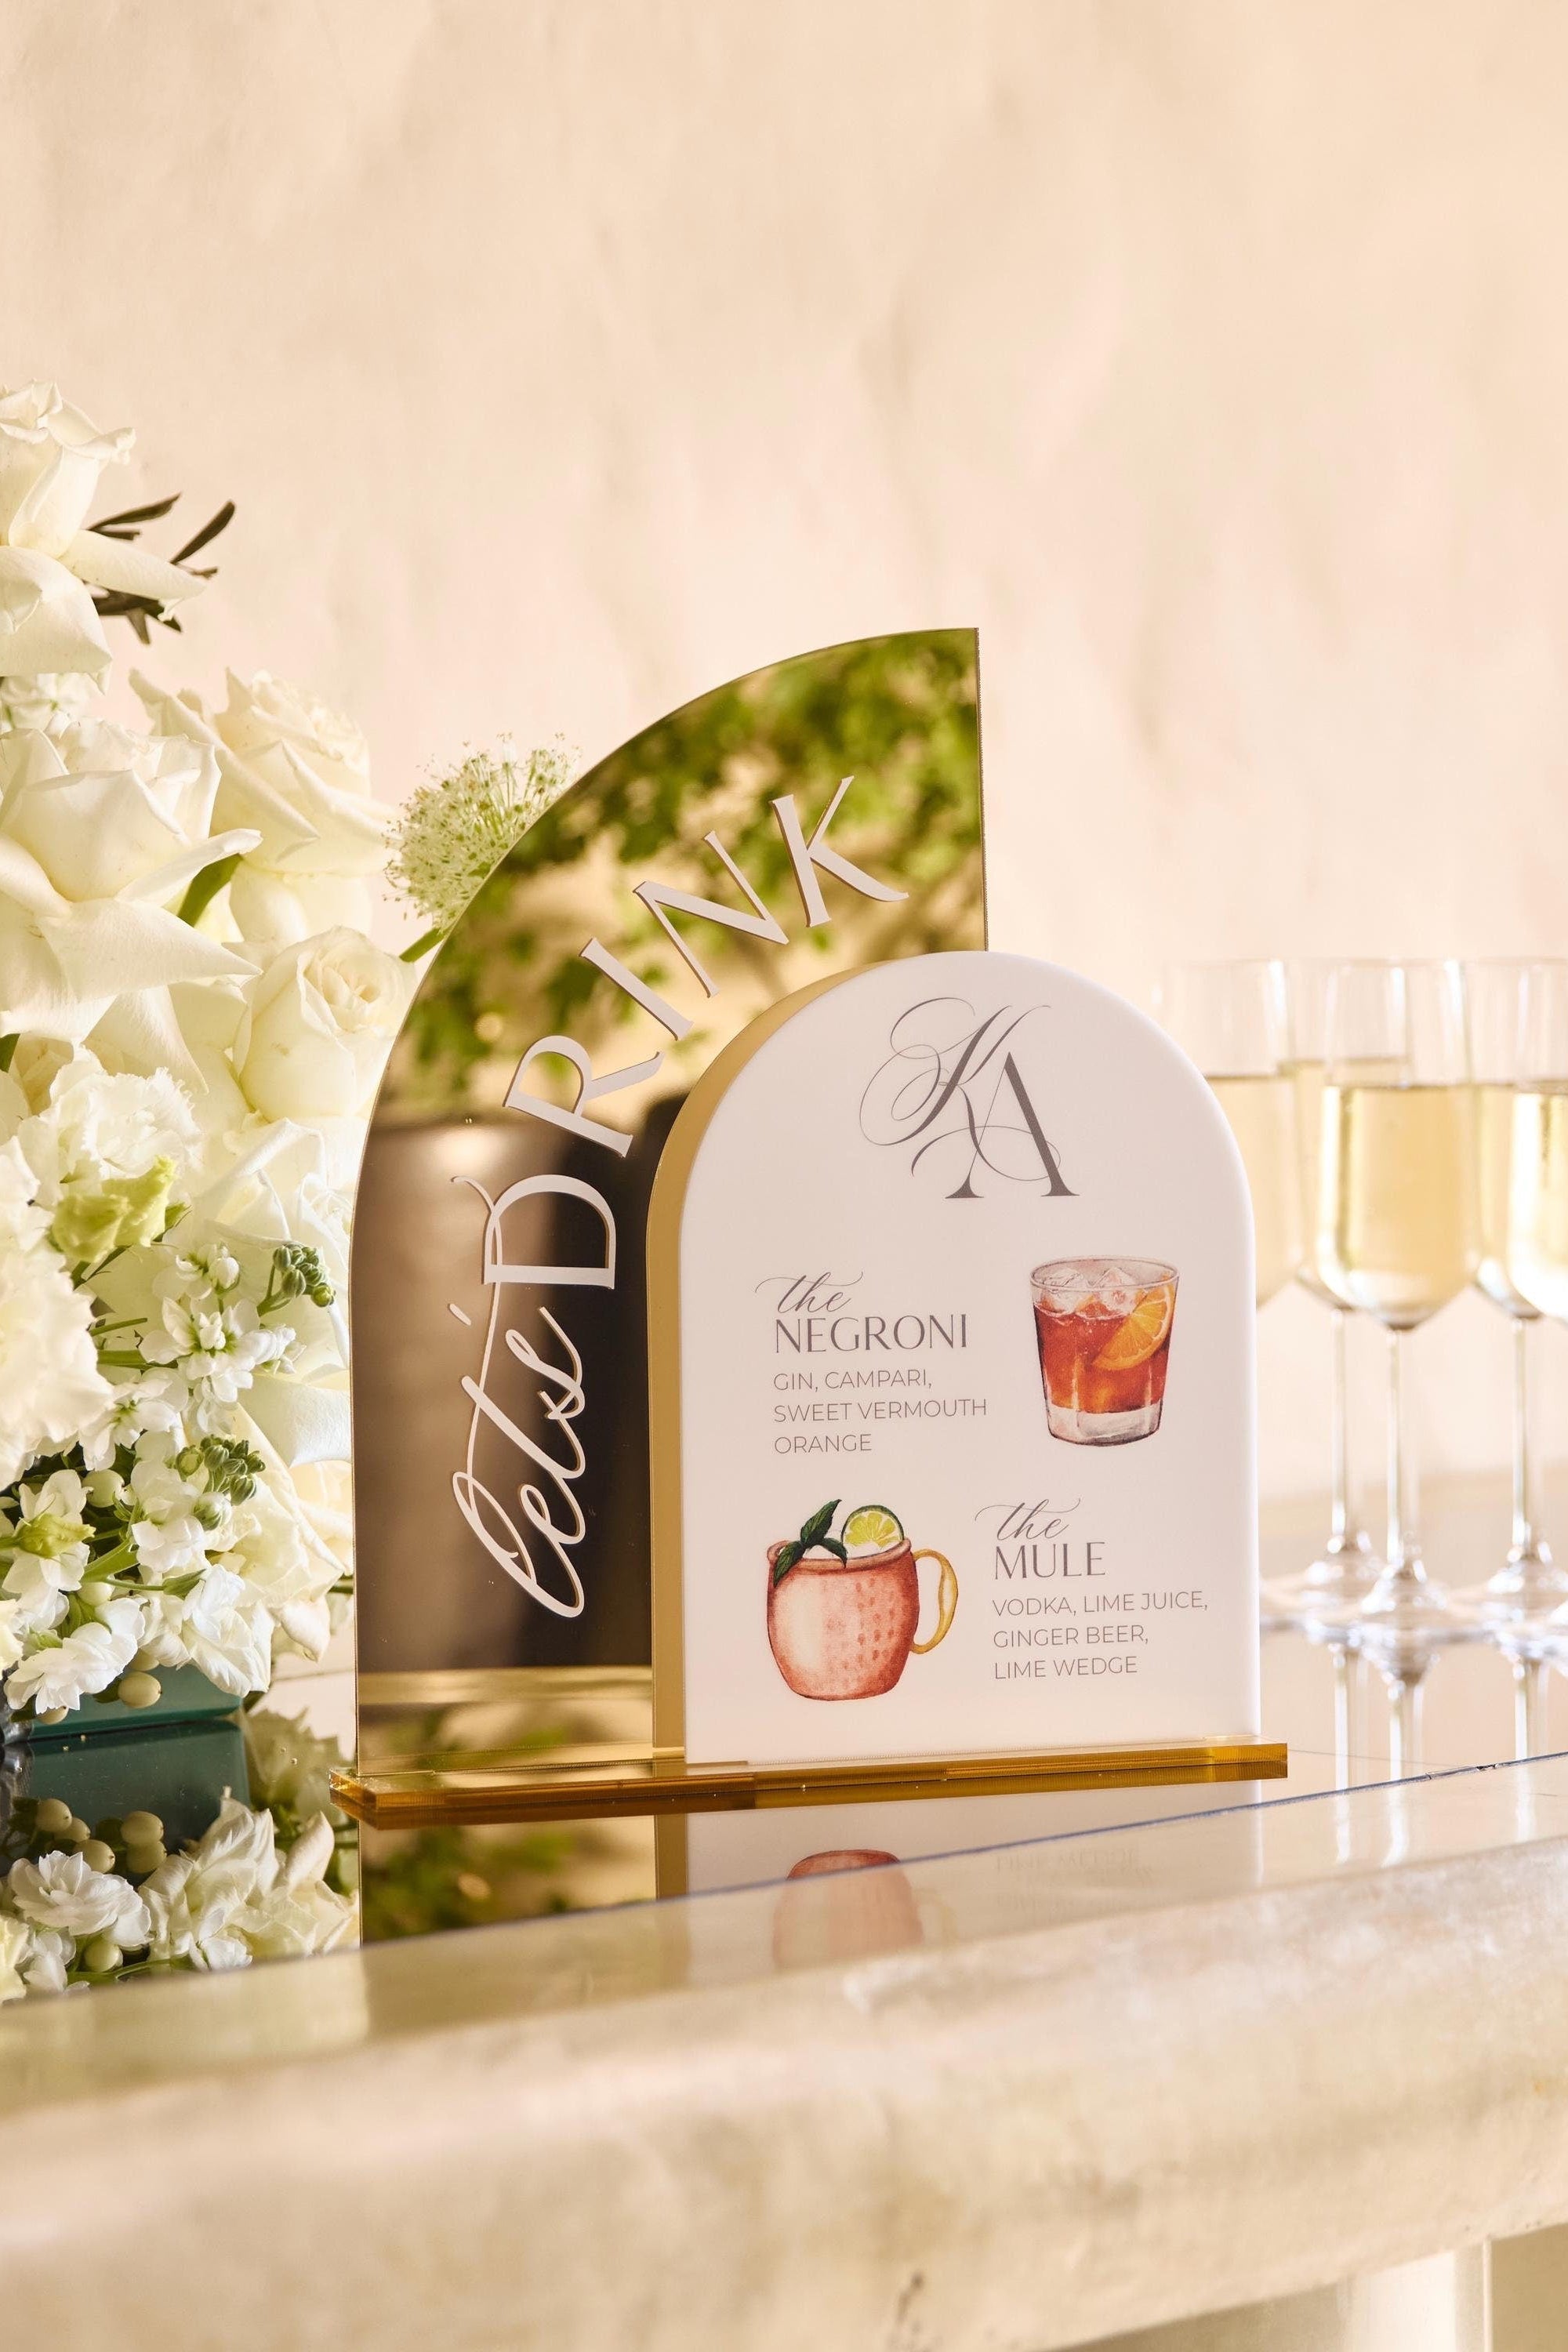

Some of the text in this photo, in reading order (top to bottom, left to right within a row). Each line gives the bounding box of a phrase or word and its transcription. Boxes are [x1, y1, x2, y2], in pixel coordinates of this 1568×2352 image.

[484, 775, 909, 1290] DRINK
[755, 1272, 864, 1313] the
[775, 1314, 967, 1353] NEGRONI
[773, 1369, 932, 1392] GIN, CAMPARI,
[774, 1399, 987, 1424] SWEET VERMOUTH
[774, 1434, 873, 1454] ORANGE
[975, 1498, 1081, 1541] the
[995, 1541, 1106, 1580] MULE
[992, 1591, 1208, 1617] VODKA, LIME JUICE,
[994, 1624, 1149, 1649] GINGER BEER,
[995, 1656, 1138, 1680] LIME WEDGE
